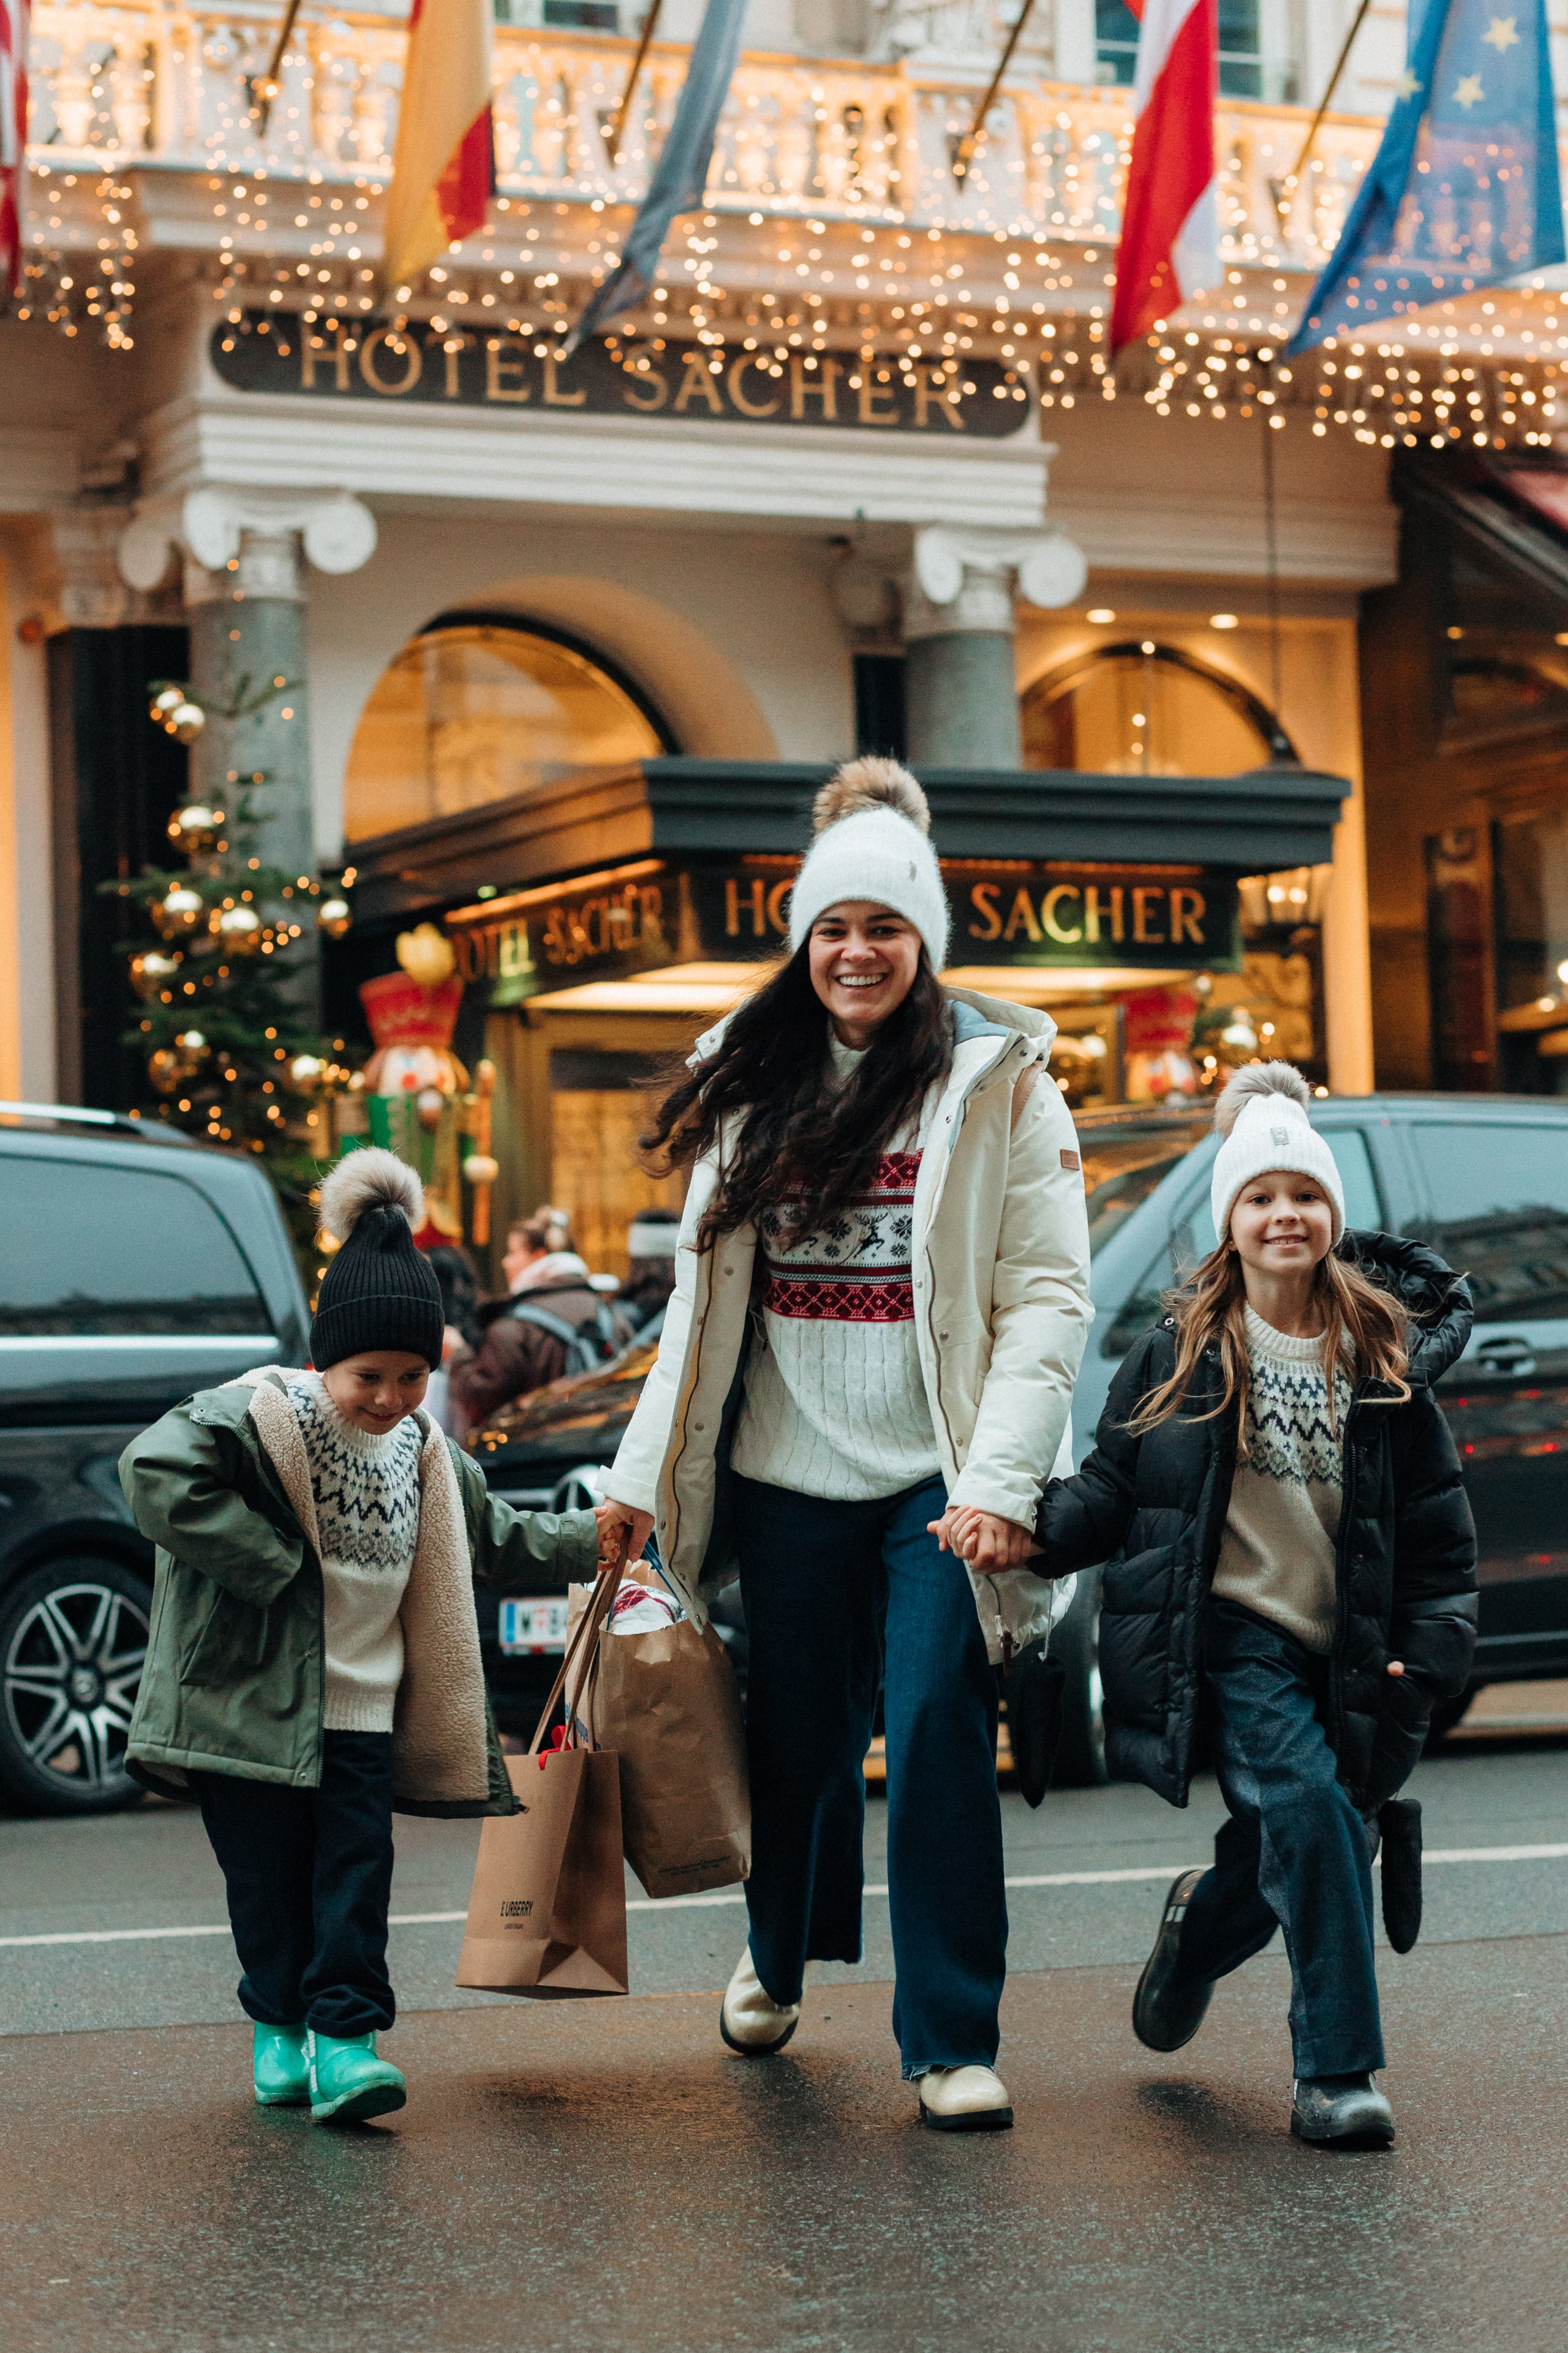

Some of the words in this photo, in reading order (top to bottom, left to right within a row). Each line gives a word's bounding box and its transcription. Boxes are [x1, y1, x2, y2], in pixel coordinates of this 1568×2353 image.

[301, 323, 587, 406] HOTEL
[622, 343, 965, 429] SACHER
[968, 883, 1207, 945] SACHER
